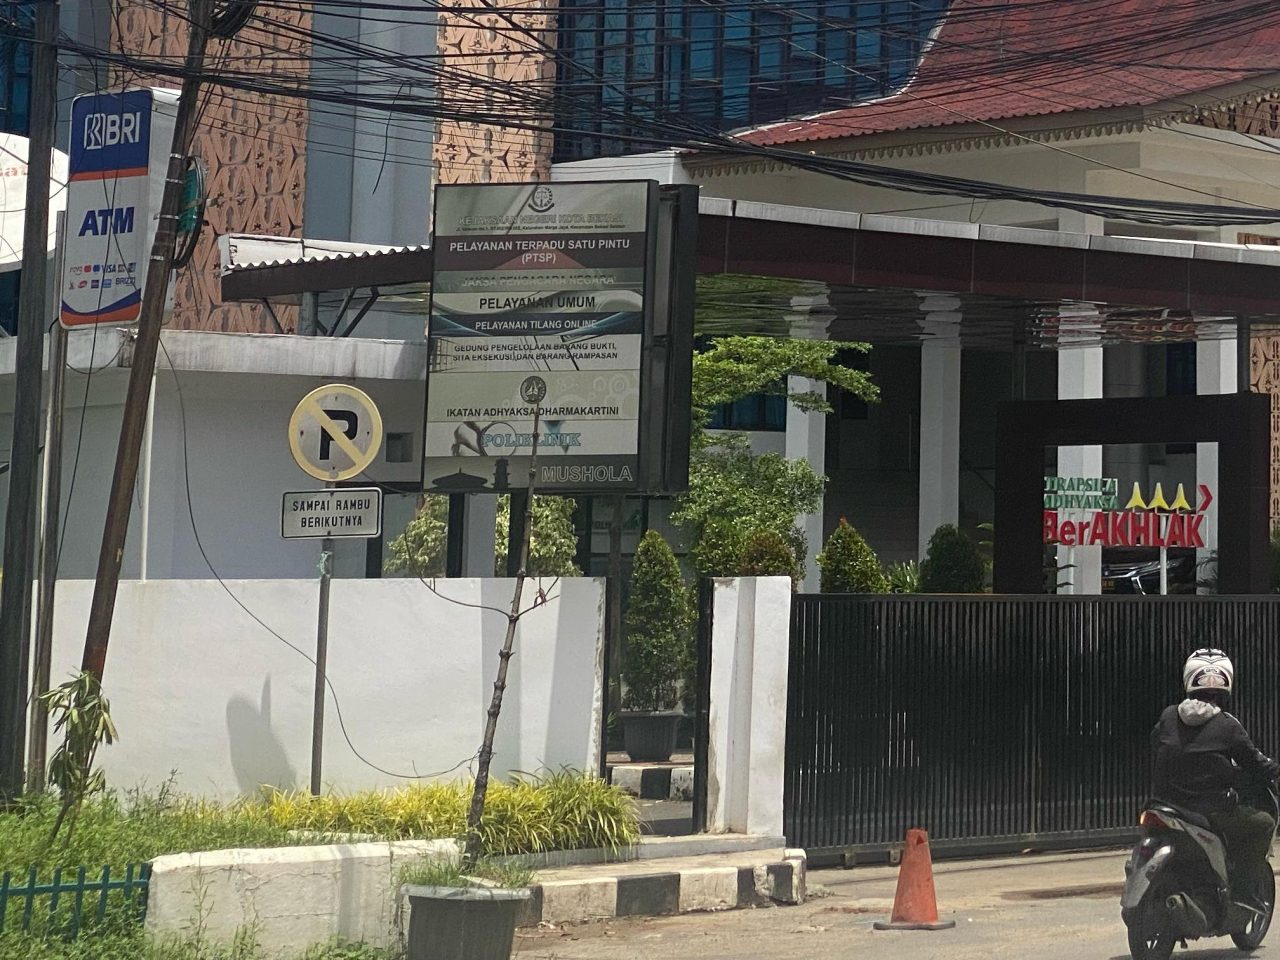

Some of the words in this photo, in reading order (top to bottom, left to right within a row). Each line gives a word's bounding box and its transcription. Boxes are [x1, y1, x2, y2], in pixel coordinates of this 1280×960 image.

[105, 112, 141, 146] BRI
[78, 206, 135, 237] ATM
[450, 241, 513, 252] PELAYANAN
[516, 240, 565, 251] TERPADU
[568, 240, 596, 249] SATU
[598, 239, 630, 249] PINTU
[521, 252, 556, 264] (PTSP)
[461, 277, 497, 287] JAKSA
[499, 276, 567, 286] PENGACARA
[569, 275, 614, 285] NEGARA
[479, 298, 553, 309] PELAYANAN
[557, 296, 595, 308] UMUM
[475, 321, 528, 330] PELAYANAN
[529, 320, 562, 329] TILANG
[564, 319, 598, 328] ONLINE
[454, 344, 489, 352] GEDUNG
[490, 343, 551, 352] PENGELOLAAN
[553, 343, 588, 351] BARANG
[590, 342, 617, 351] BUKTI,
[516, 353, 534, 361] DAN
[572, 352, 618, 360] RAMPASAN
[446, 408, 481, 417] IKATAN
[483, 407, 535, 417] ADHYAKSA
[537, 406, 619, 416] DHARMAKARTINI
[481, 432, 581, 447] POLIKLINIK
[541, 465, 633, 482] MUSHOLA
[292, 500, 330, 512] SAMPAI
[335, 499, 370, 510] RAMBU
[300, 515, 363, 528] BERIKUTNYA
[1042, 510, 1205, 547] BerAKHLAK
